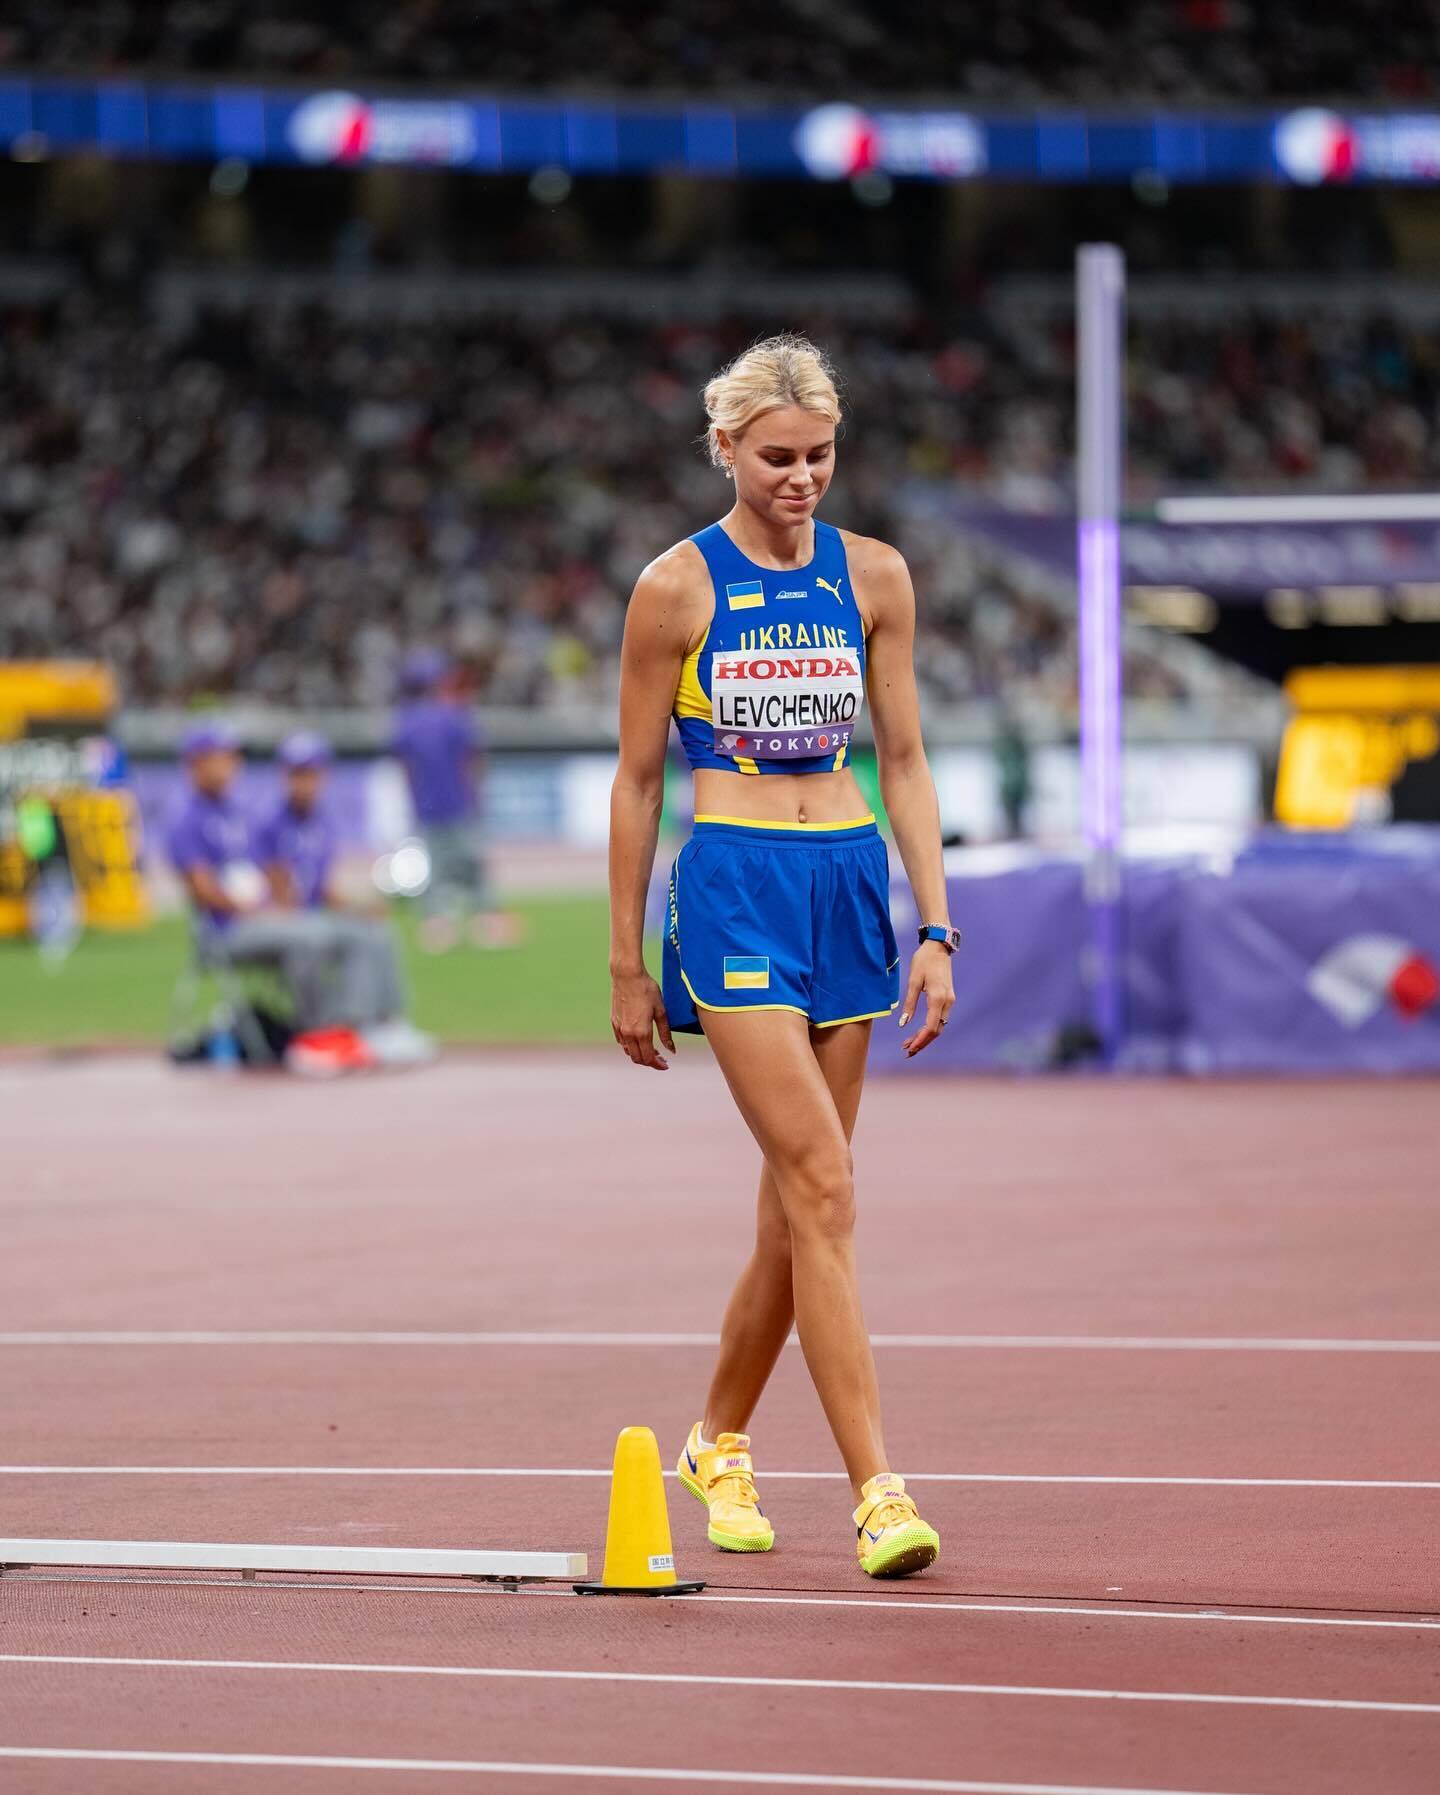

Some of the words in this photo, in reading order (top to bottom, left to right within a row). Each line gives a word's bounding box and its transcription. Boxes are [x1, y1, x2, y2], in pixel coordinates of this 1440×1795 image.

[740, 623, 848, 650] UKRAINE
[715, 658, 858, 680] HONDA
[719, 692, 856, 728] LEVCHENKO
